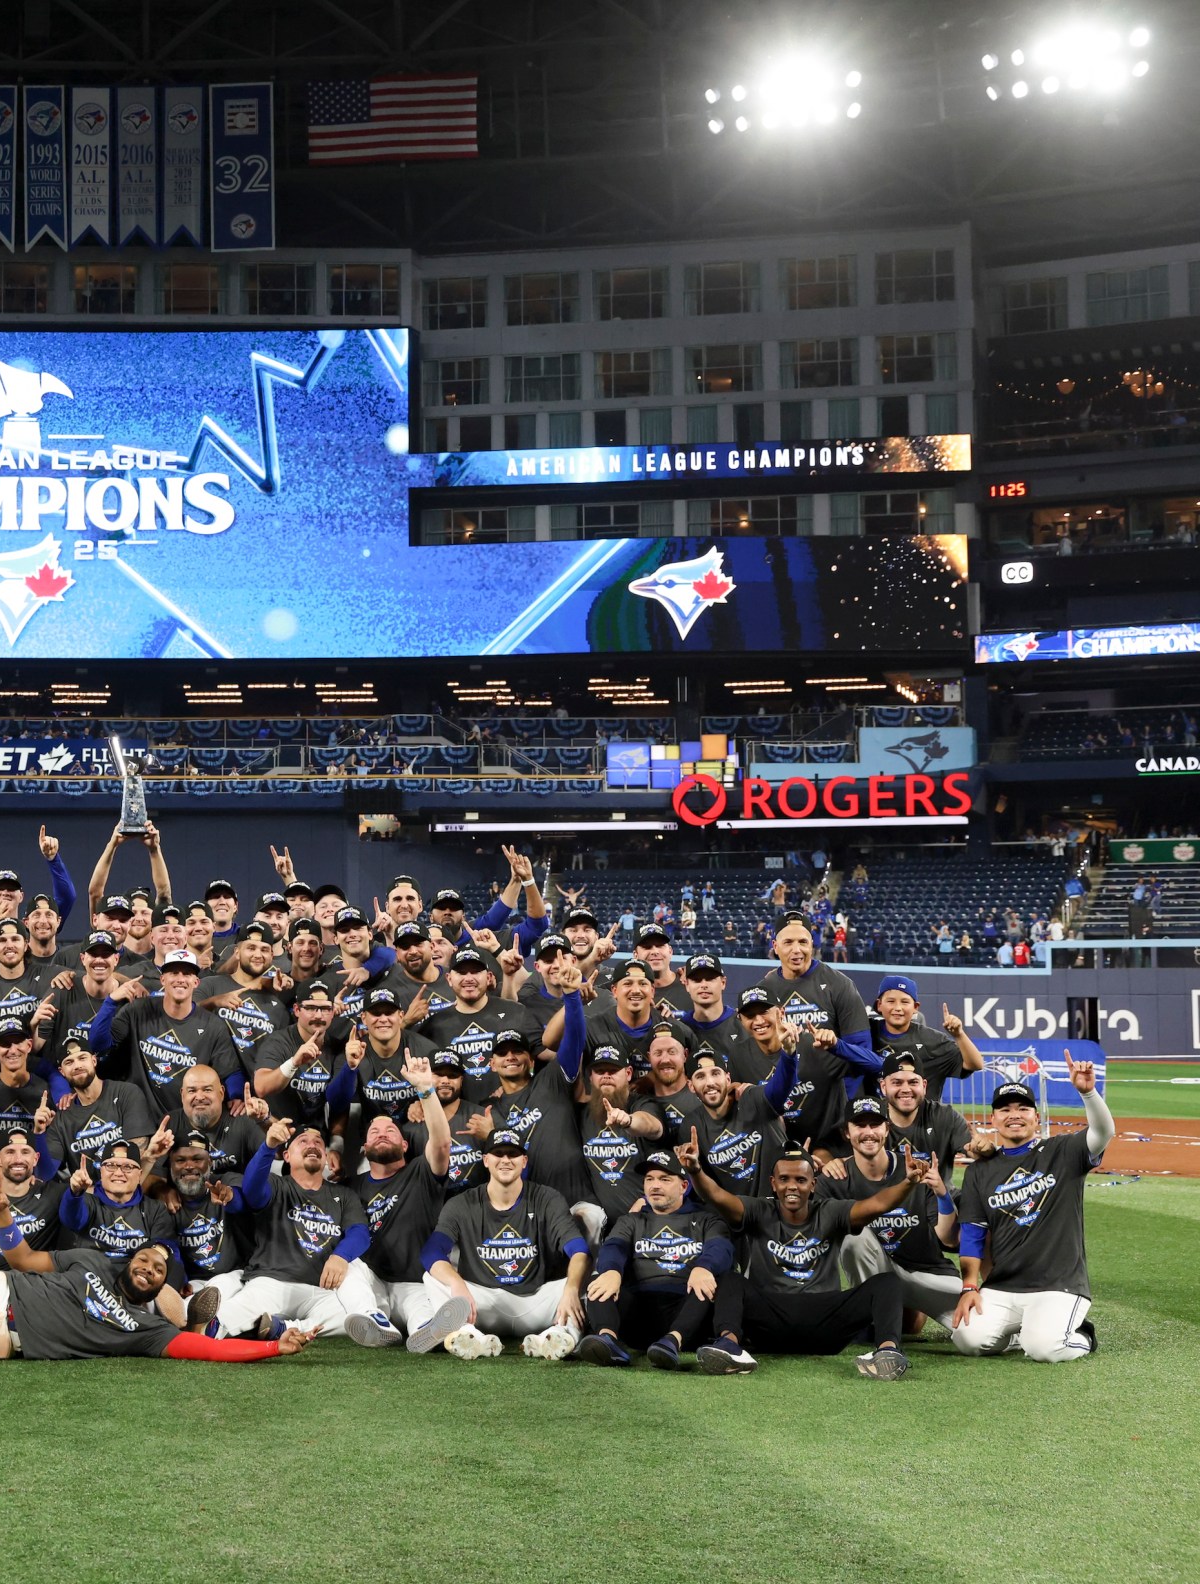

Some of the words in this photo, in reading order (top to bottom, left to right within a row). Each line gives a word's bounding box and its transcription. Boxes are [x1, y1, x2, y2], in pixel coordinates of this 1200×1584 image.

[30, 144, 60, 165] 1993
[74, 144, 108, 165] 2015
[121, 144, 153, 165] 2016
[30, 170, 61, 182] WORLD
[76, 171, 105, 184] A.L.
[124, 170, 152, 183] A.L.
[215, 155, 270, 194] 32
[30, 186, 61, 199] SERIES
[29, 203, 62, 216] CHAMPS
[74, 208, 106, 216] CHAMPS
[122, 208, 153, 216] CHAMPS
[51, 449, 179, 470] LEAGUE
[633, 450, 717, 473] LEAGUE
[728, 445, 865, 470] CHAMPIONS
[73, 540, 119, 561] 25
[1006, 566, 1029, 580] CC
[82, 748, 146, 762] FLIHT
[1135, 756, 1200, 772] CANAD
[743, 772, 973, 820] ROGERS
[218, 1007, 275, 1034] CHAMPIONS
[781, 1011, 829, 1024] AMPIONS
[140, 1040, 197, 1067] CHAMPIONS
[71, 1126, 123, 1152] CHAMPIONS
[583, 1144, 639, 1158] CHAMPIONS
[708, 1131, 762, 1165] CHAMPIONS
[737, 1167, 754, 1179] 2025
[987, 1173, 1057, 1209] CHAMPIONS
[1001, 1181, 1022, 1191] AMERICAN
[867, 1214, 920, 1228] AMPIONS
[1019, 1213, 1038, 1224] 2025
[89, 1226, 149, 1249] CHAMPION
[476, 1245, 538, 1260] CHAMPIONS
[767, 1239, 830, 1264] CHAMPIONS
[199, 1256, 217, 1265] 2025
[84, 1271, 140, 1332] CHAMPIONS
